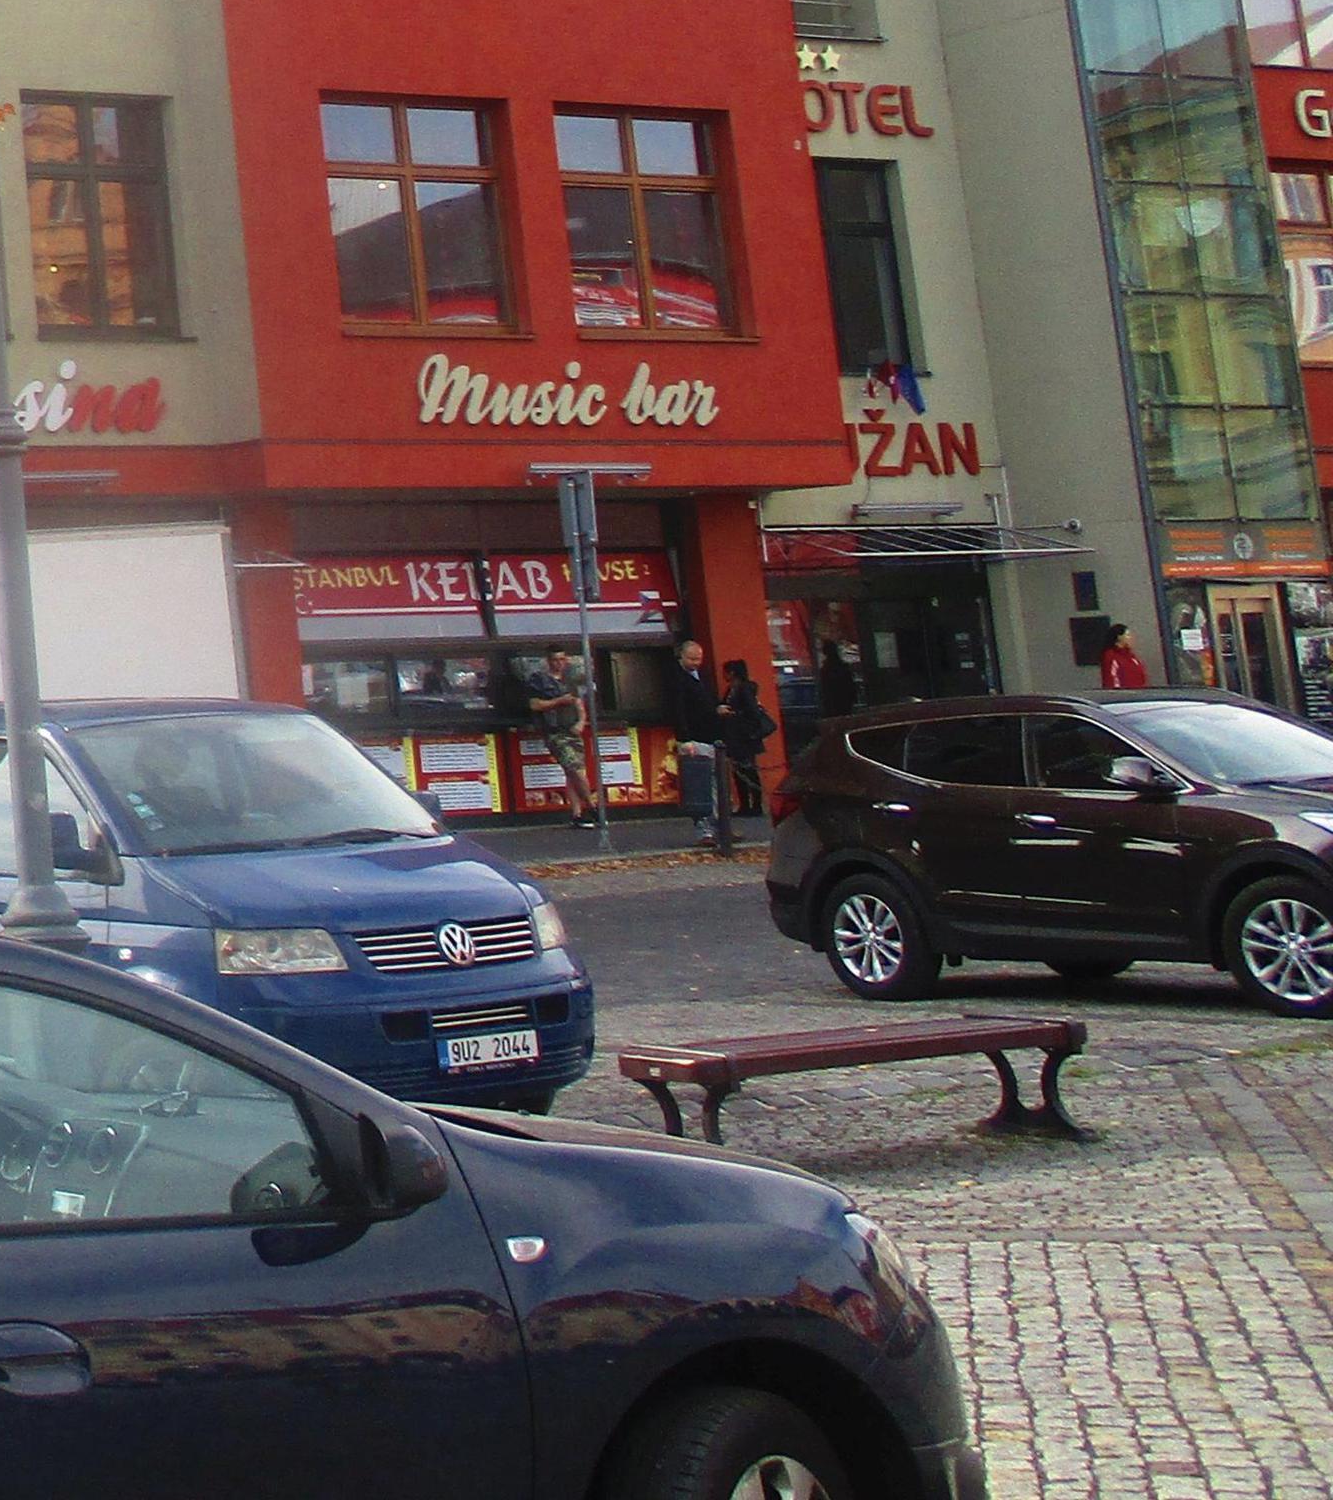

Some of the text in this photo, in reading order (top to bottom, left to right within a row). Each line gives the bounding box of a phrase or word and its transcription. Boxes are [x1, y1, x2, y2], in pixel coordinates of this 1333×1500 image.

[801, 79, 935, 137] OTEL
[417, 353, 719, 427] Music bar
[292, 564, 400, 591] STANBUL
[451, 1034, 531, 1063] 9U2 2044
